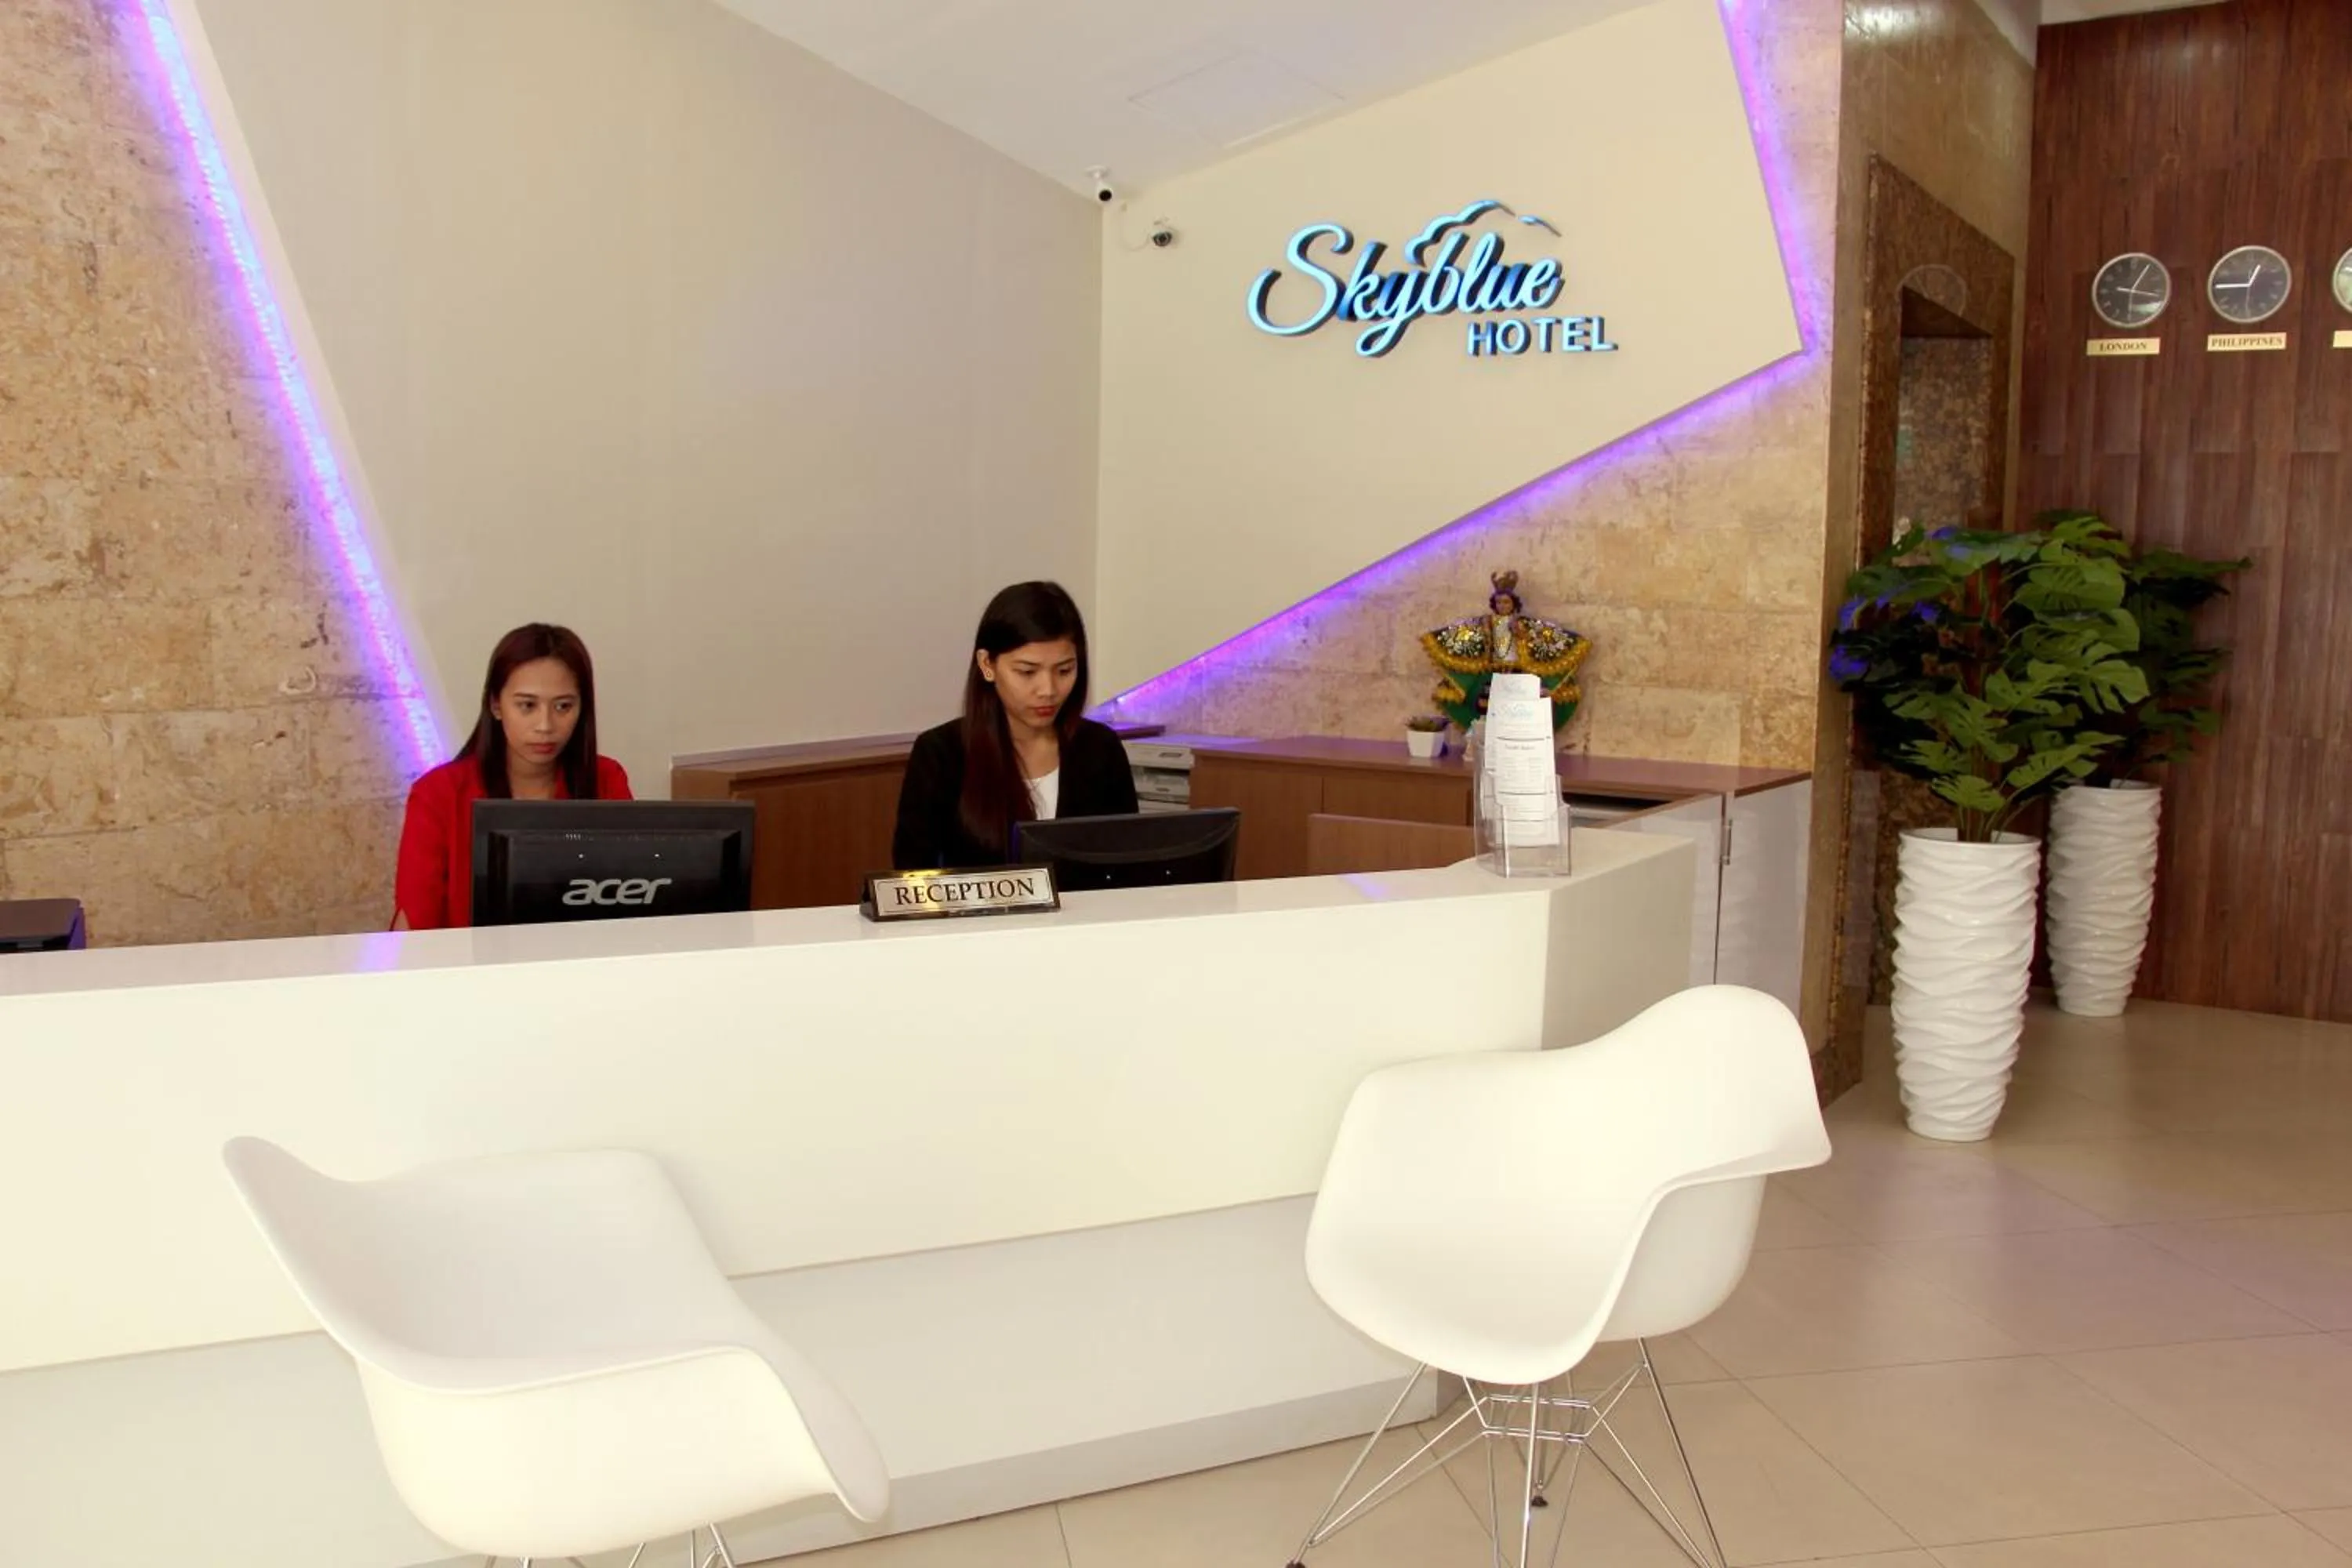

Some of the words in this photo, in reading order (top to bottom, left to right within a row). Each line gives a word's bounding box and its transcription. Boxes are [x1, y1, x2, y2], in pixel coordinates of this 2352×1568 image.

[1247, 223, 1565, 358] Skyblue
[1467, 315, 1618, 356] HOTEL
[2099, 341, 2147, 352] LONDON
[2211, 336, 2283, 348] PHILIPPINES
[562, 878, 672, 906] acer
[894, 877, 1035, 906] RECEPTION
